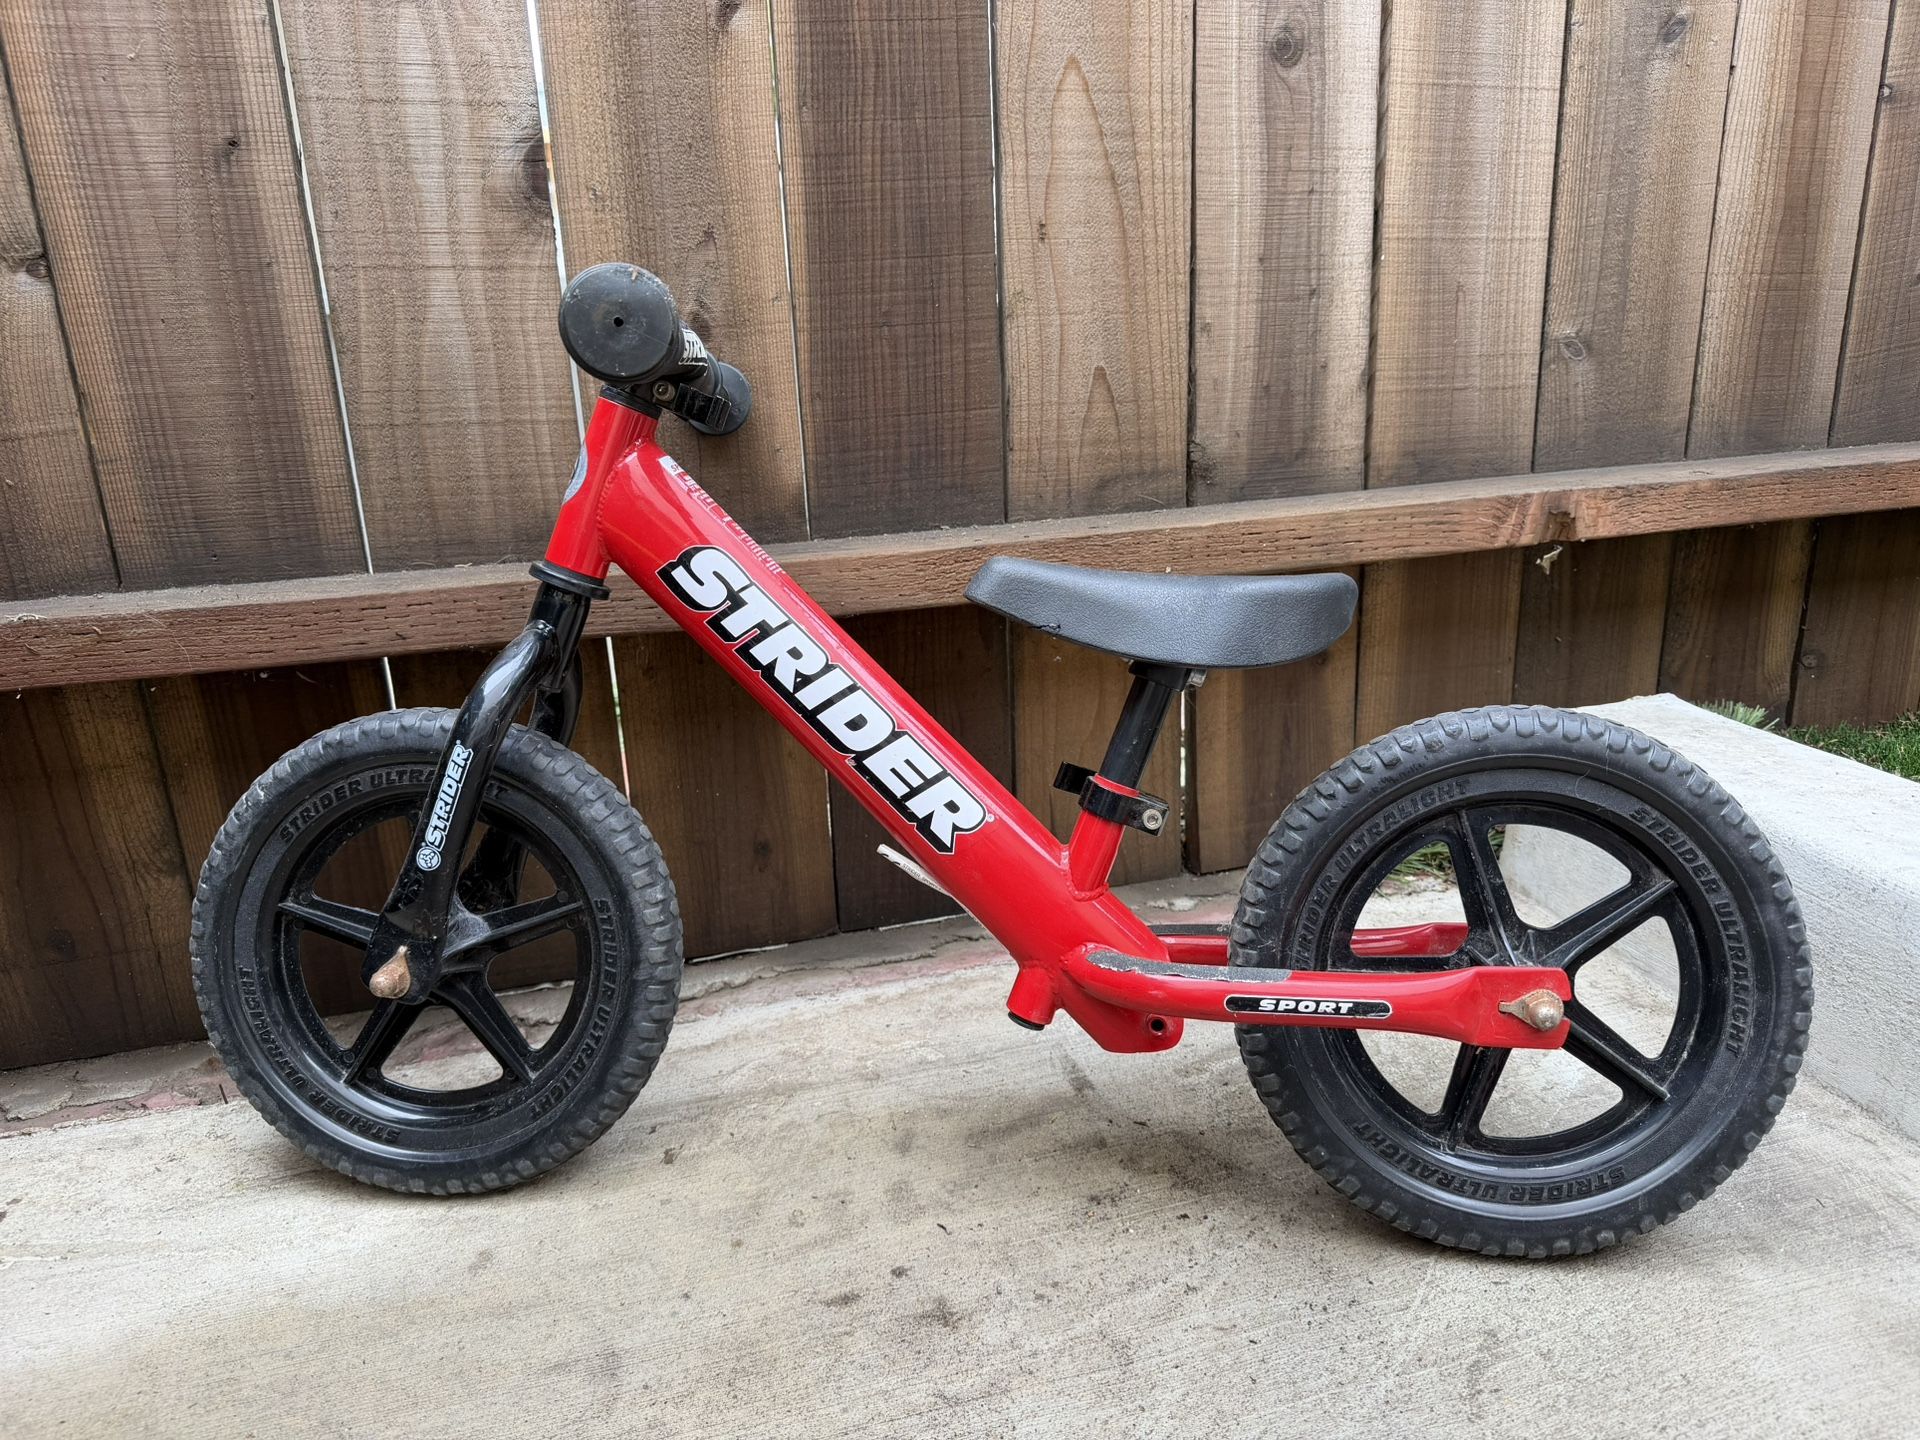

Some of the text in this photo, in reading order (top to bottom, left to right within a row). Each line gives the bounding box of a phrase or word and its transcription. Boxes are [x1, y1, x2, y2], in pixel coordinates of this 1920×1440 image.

[656, 546, 988, 853] STRIDER
[280, 779, 362, 844] STRIDER
[425, 745, 473, 851] STRIDER
[1335, 779, 1471, 873] ULTRALIGHT
[1629, 806, 1750, 1058] STRIDER ULTRALIGHT
[530, 899, 618, 1118] STRIDER ULTRALIGHT
[1258, 999, 1354, 1014] SPORT
[309, 1090, 401, 1143] STRIDER
[1353, 1122, 1625, 1201] STRIDER ULTRALIGHT
